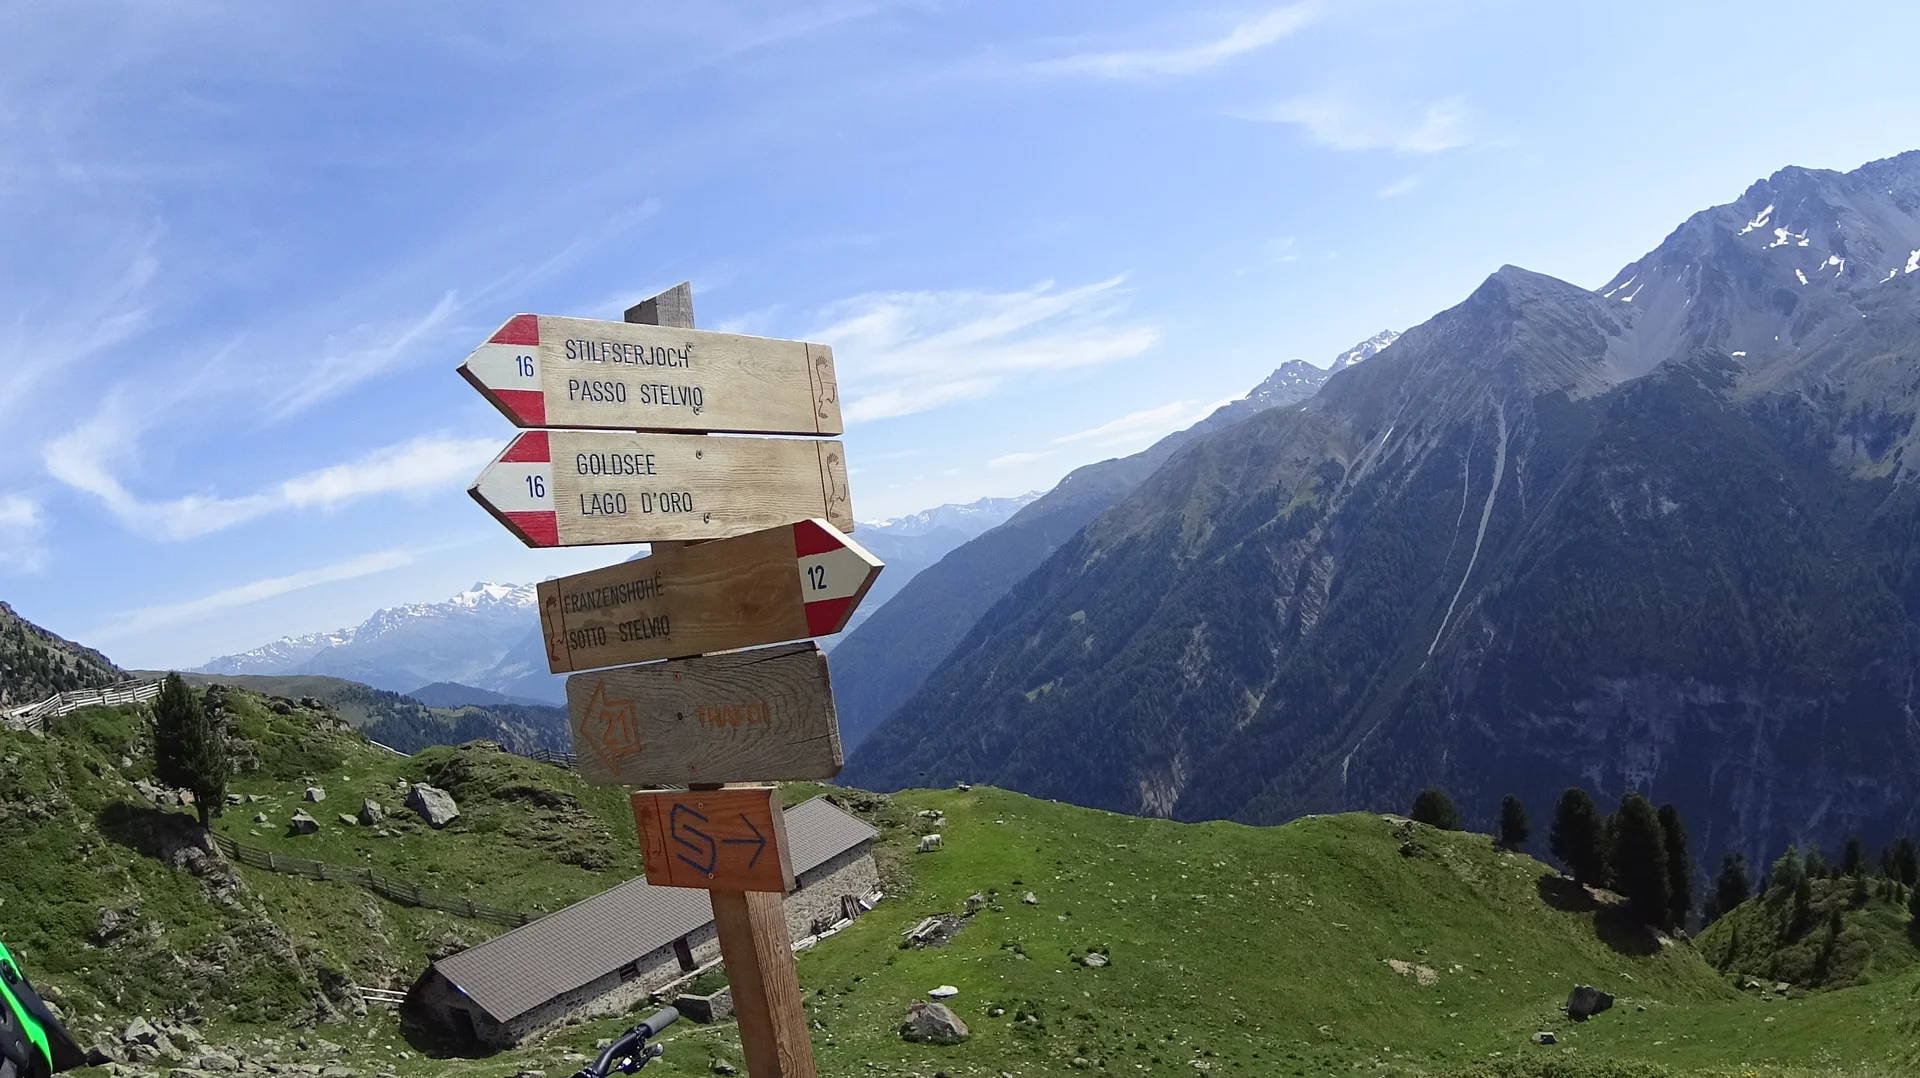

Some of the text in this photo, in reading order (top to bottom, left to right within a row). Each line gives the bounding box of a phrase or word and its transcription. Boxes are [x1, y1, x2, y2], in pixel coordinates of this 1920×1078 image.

[515, 354, 534, 378] 16
[565, 339, 690, 368] STILFSERJOCH
[568, 379, 703, 407] PASSO STELVIO
[576, 453, 657, 476] GOLDSEE
[525, 475, 545, 499] 16
[580, 492, 693, 515] LAGO D'ORO
[807, 565, 827, 591] 12
[569, 615, 670, 650] SOTTO STELVIO
[601, 710, 632, 746] 21
